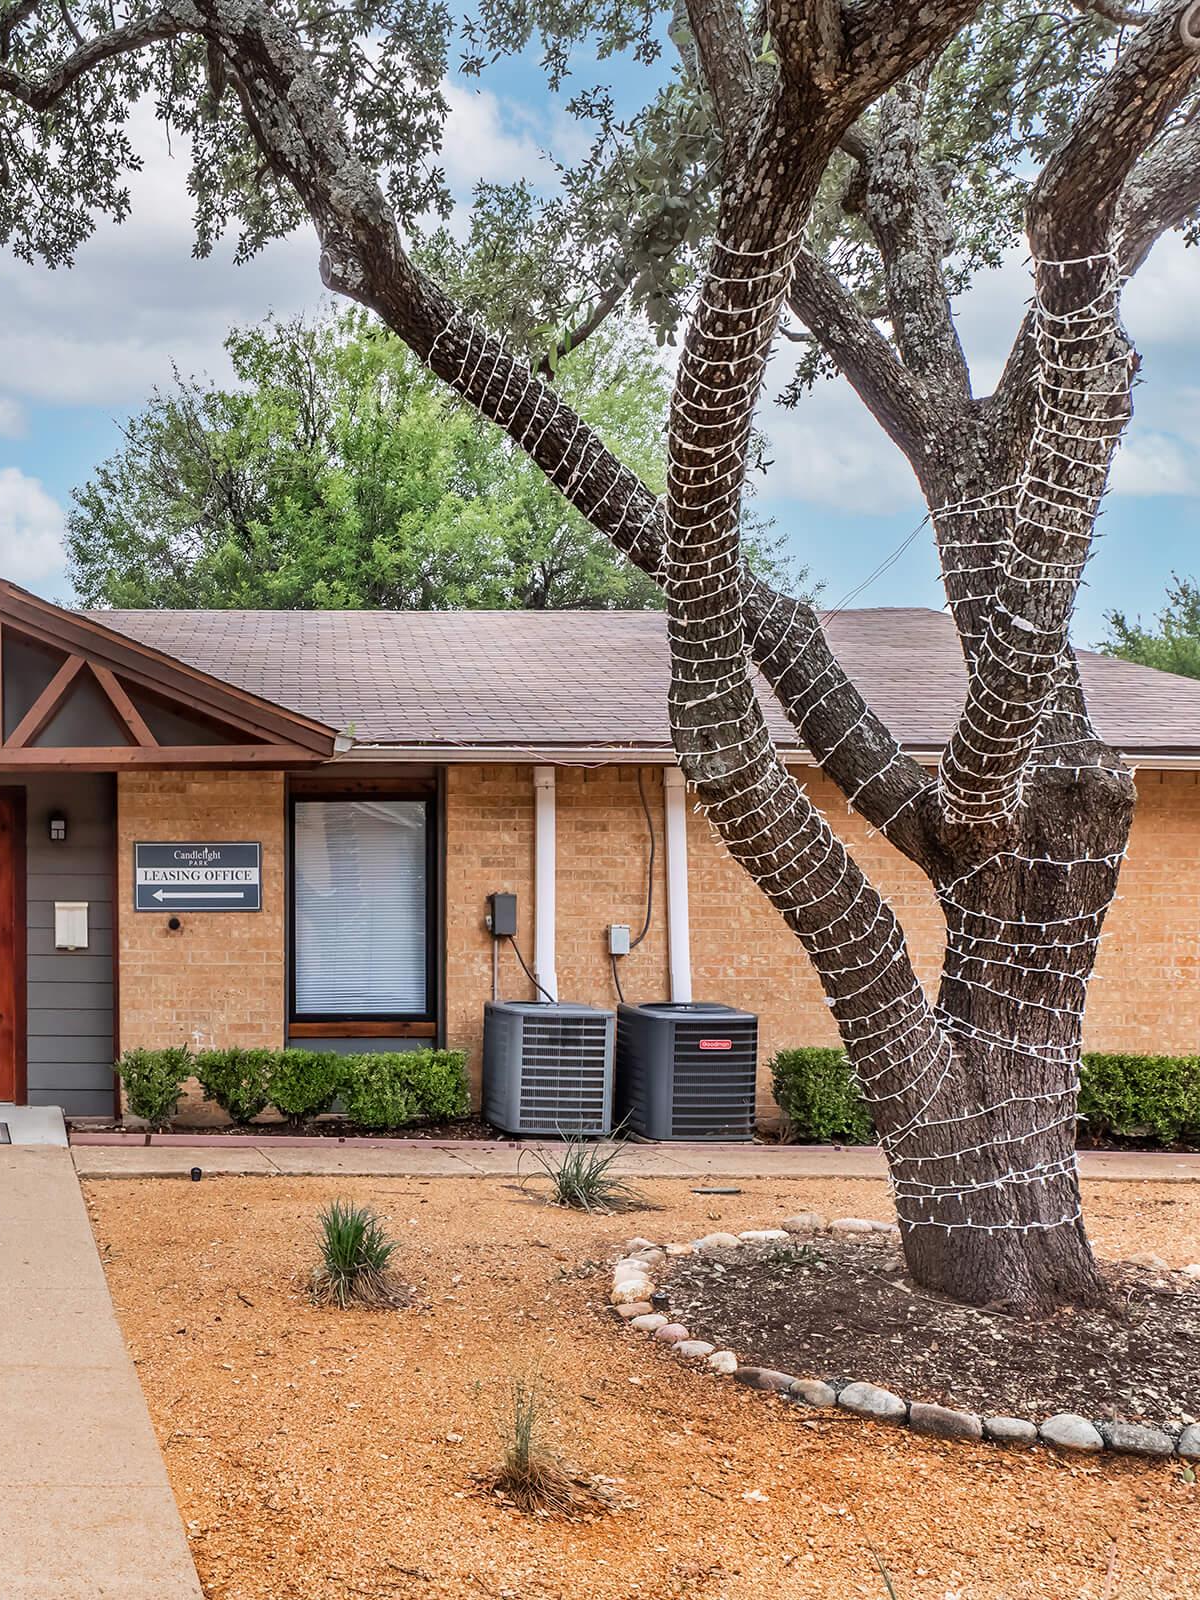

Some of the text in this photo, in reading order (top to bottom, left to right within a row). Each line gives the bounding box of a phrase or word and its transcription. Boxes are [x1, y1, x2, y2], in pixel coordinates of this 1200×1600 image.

[173, 848, 221, 861] Candlelight
[144, 870, 252, 881] LEASING OFFICE
